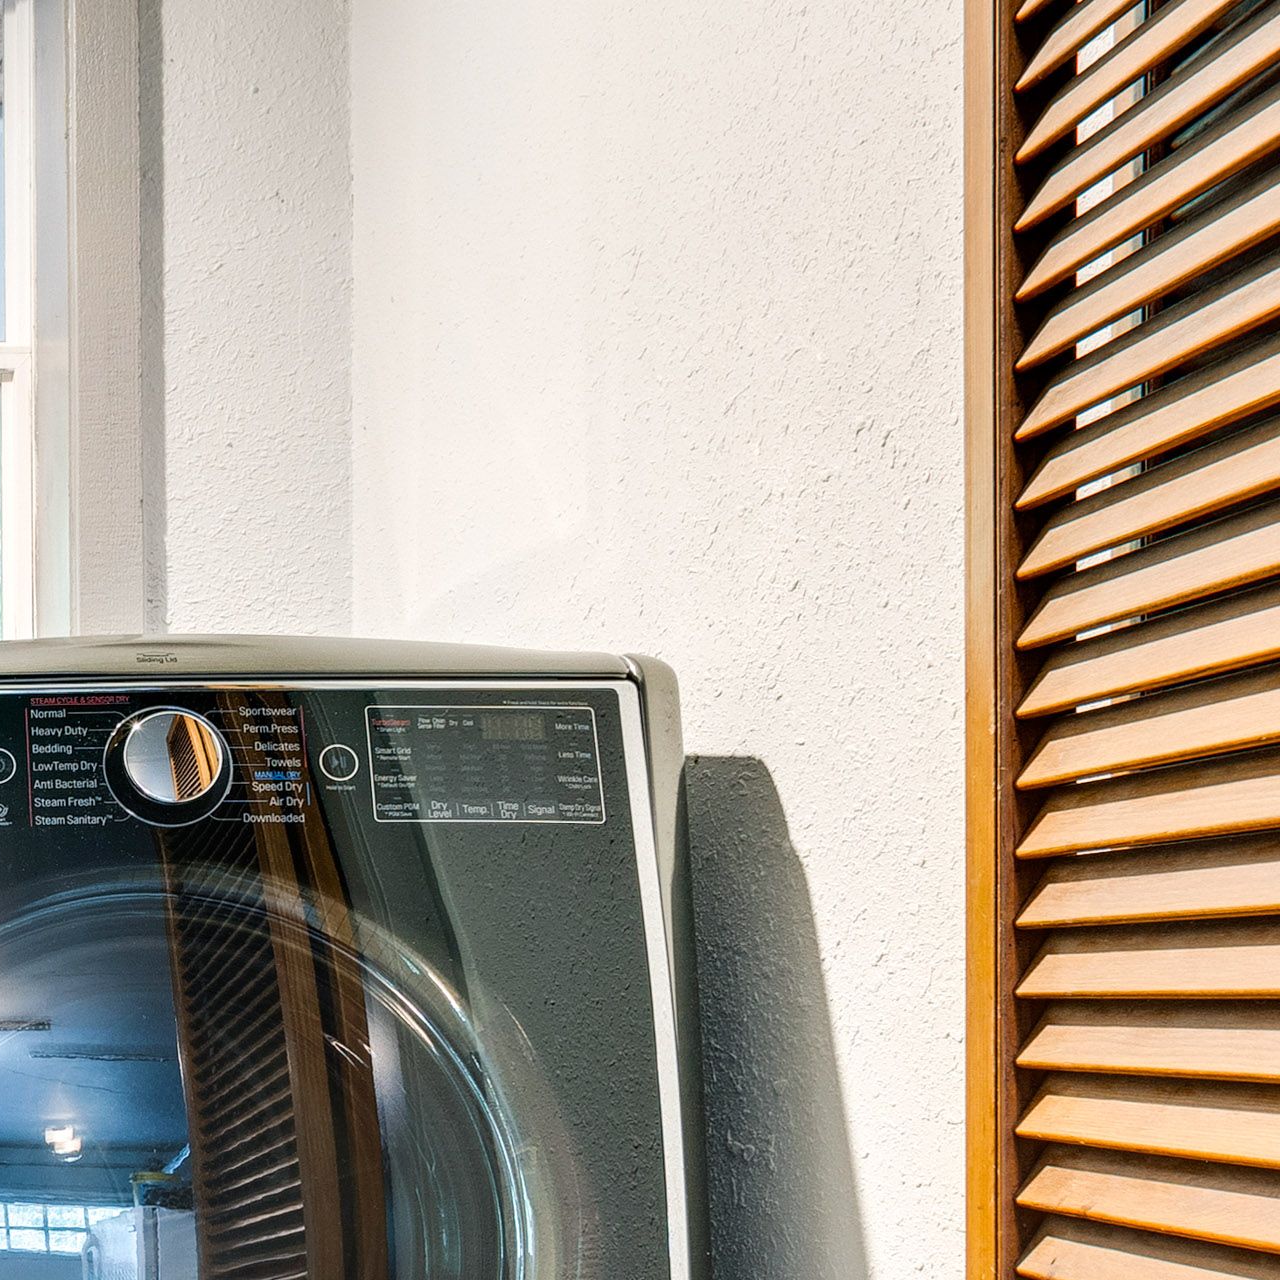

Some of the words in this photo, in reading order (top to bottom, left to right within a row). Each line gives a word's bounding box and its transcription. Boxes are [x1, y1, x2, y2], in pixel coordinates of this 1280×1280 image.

[30, 697, 56, 705] STEAM
[30, 709, 67, 719] Normal
[239, 706, 297, 717] Sportswear
[31, 727, 63, 737] Heavy
[64, 725, 89, 737] Duty
[243, 723, 299, 734] Perm.Press
[32, 744, 73, 755] Bedding
[254, 741, 300, 752] Delicates
[558, 751, 574, 759] Less
[575, 751, 592, 759] Time
[80, 761, 98, 772] Dry
[265, 757, 301, 768] Towels
[254, 770, 285, 779] MANUAL
[285, 770, 301, 779] DRY
[374, 775, 397, 783] Energy
[557, 775, 582, 783] Wrinkle
[33, 779, 54, 790] Anti
[55, 779, 98, 789] Bacterial
[251, 781, 283, 793] Speed
[284, 781, 303, 794] Dry
[34, 797, 66, 807] Steam
[269, 796, 284, 807] Air
[286, 796, 304, 808] Dry
[376, 803, 402, 811] Custom
[431, 800, 447, 811] Dry
[497, 800, 519, 810] Time
[428, 809, 452, 818] Level
[462, 804, 490, 815] Temp.
[528, 805, 555, 816] Signal
[559, 803, 574, 812] Damp
[575, 804, 584, 812] Dry
[585, 804, 601, 813] Signal
[243, 812, 305, 823] Downloaded
[501, 809, 517, 819] Dry
[35, 815, 66, 826] Steam
